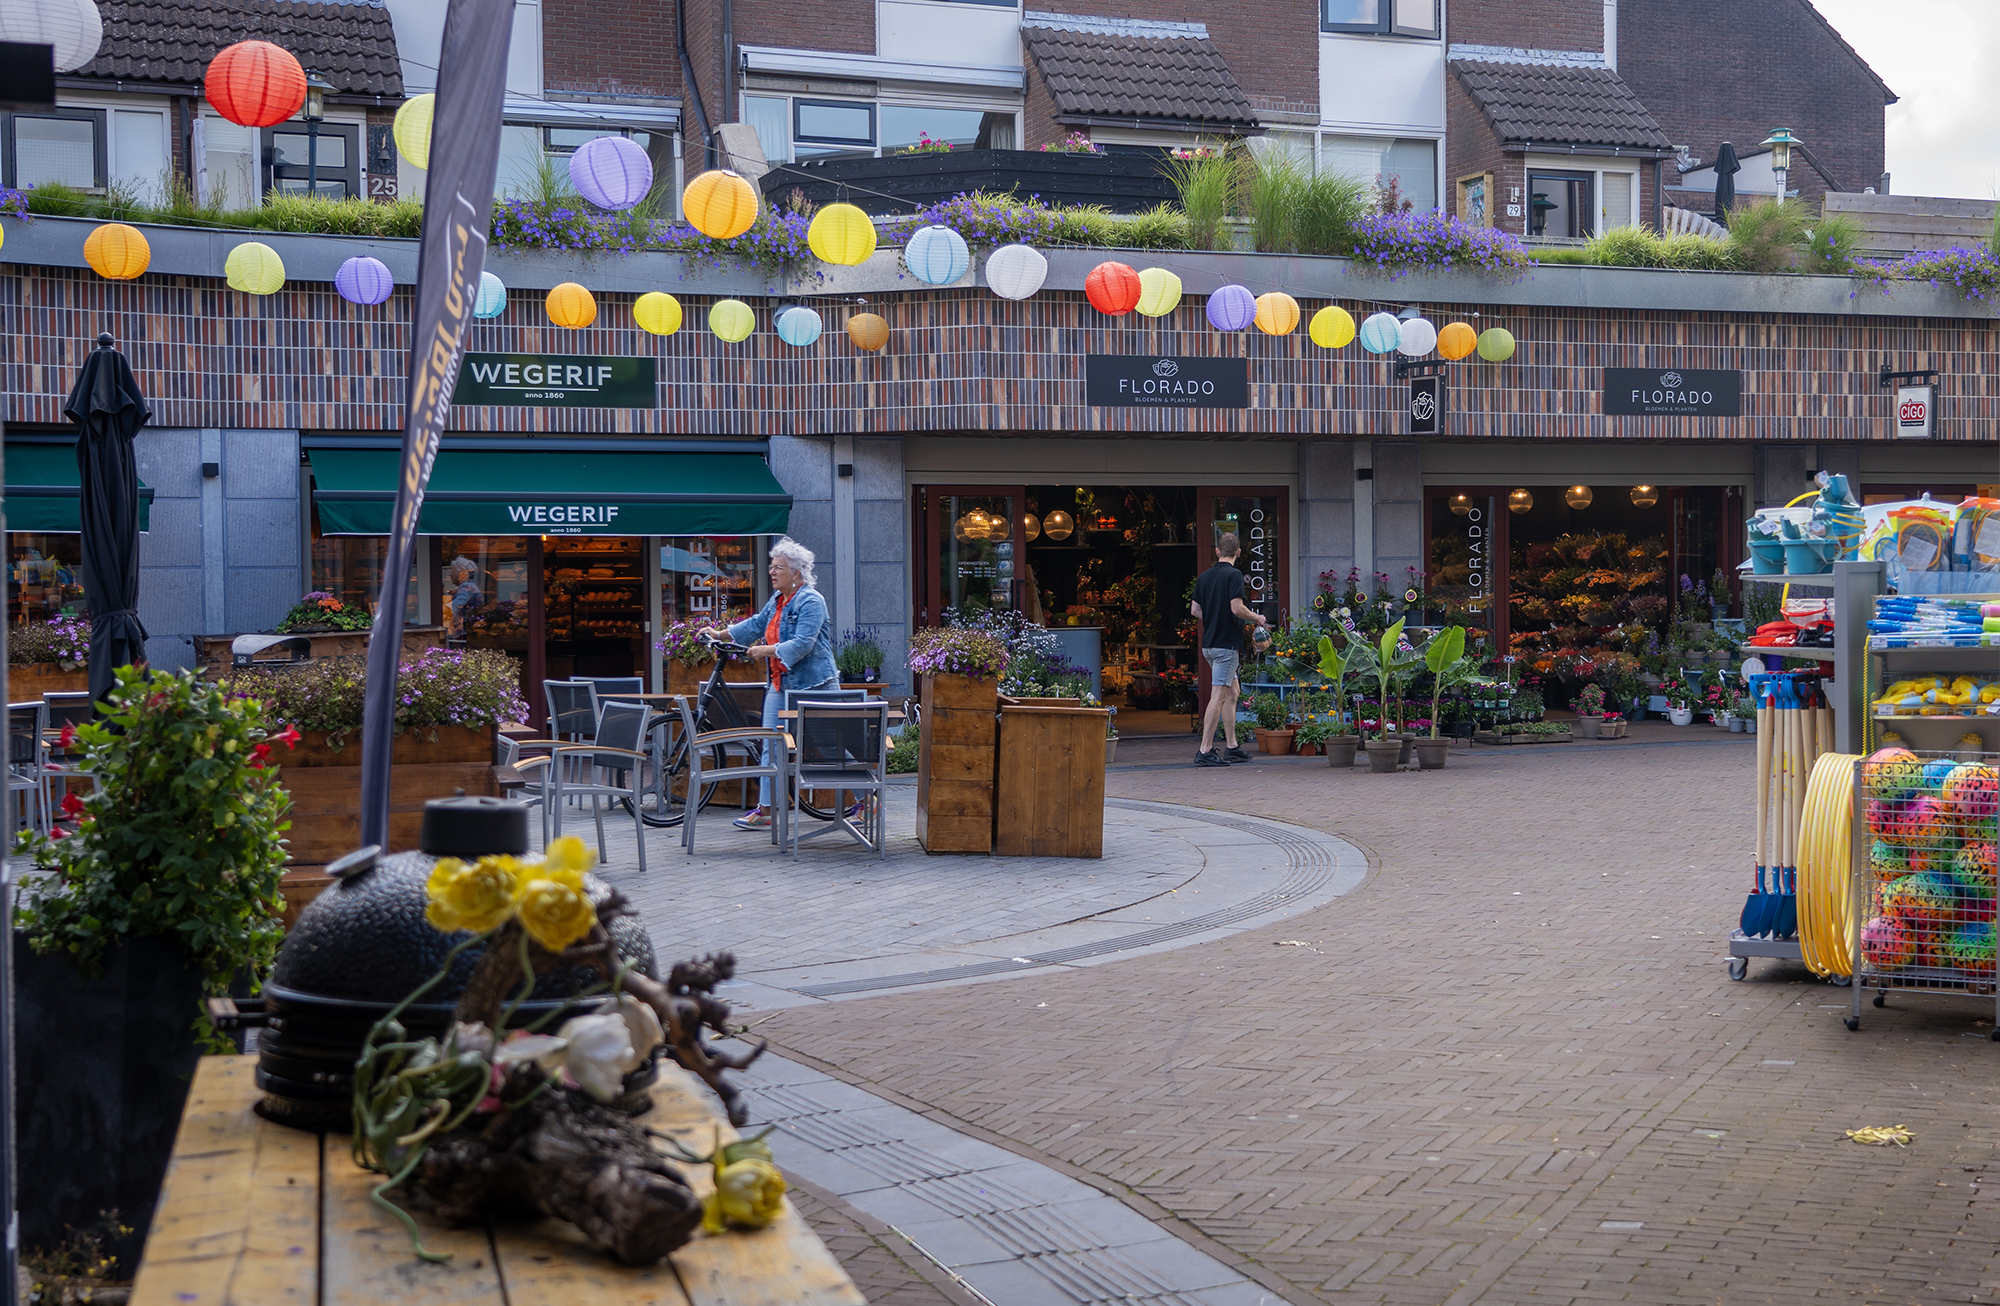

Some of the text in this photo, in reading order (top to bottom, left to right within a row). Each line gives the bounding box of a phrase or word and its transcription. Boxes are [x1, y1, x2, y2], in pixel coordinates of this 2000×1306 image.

[371, 178, 397, 195] 25
[1508, 206, 1520, 215] 29
[471, 362, 613, 386] WEGERIF
[1119, 379, 1215, 395] FLORADO
[1632, 390, 1713, 404] FLORADO
[422, 431, 441, 482] VAN
[508, 505, 619, 522] WEGERIF
[1468, 508, 1482, 613] FLORADO
[690, 542, 711, 624] ERIF
